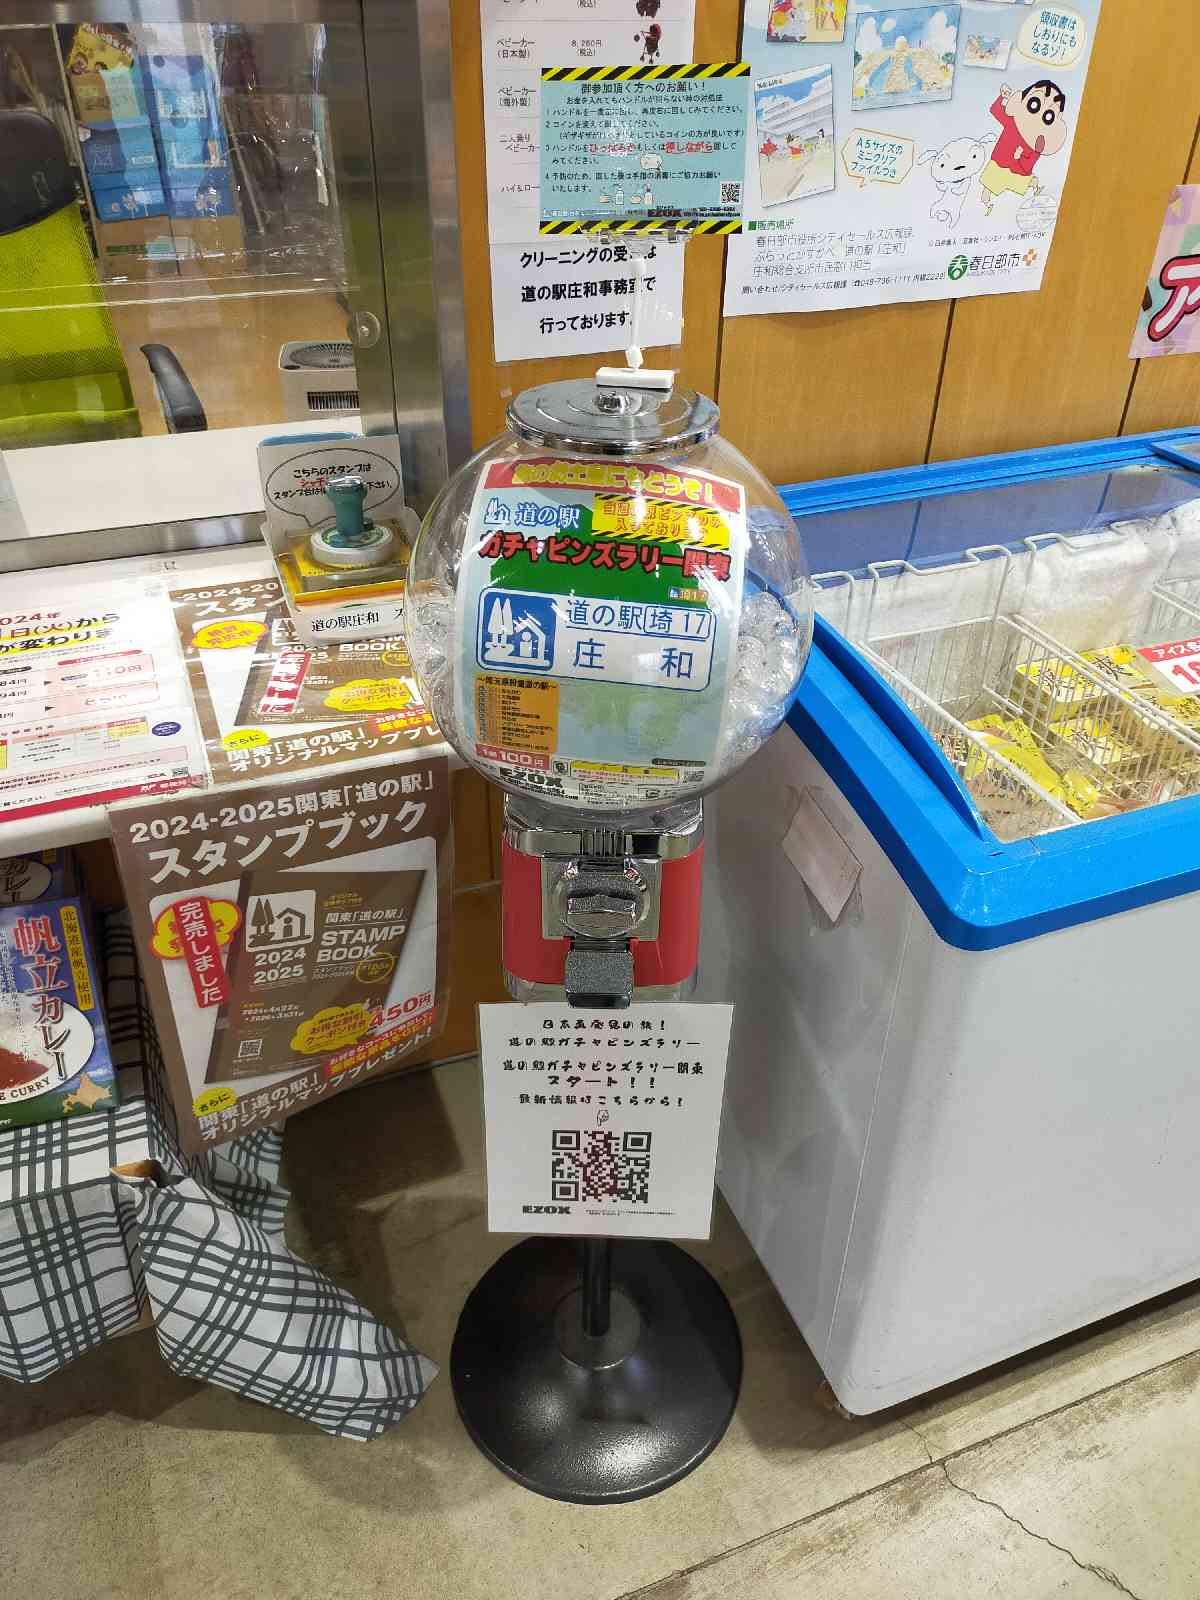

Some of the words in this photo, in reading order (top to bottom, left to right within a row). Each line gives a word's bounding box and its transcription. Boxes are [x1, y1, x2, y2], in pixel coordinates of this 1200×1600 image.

[497, 38, 535, 48] ベビーカー
[498, 88, 536, 97] ベビーカー
[969, 253, 1020, 271] 春日部市
[293, 463, 372, 479] こちらのスタンプは
[515, 502, 581, 529] 道の駅
[311, 612, 379, 632] 道の駅庄和
[566, 600, 644, 631] 道の駅
[228, 727, 366, 761] 関東「道の駅」
[129, 770, 434, 844] 2024-2025関東「道の駅」
[149, 800, 428, 883] スタンプブック
[325, 907, 404, 924] 関東「道の駅」
[320, 925, 405, 946] STAMP
[178, 900, 224, 1005] 完売しました
[254, 947, 307, 967] 2024
[316, 943, 378, 962] BOOK
[12, 915, 72, 1081] 帆立カレー
[508, 1036, 701, 1048] 道の駅ガチャピンズラリー
[502, 1059, 704, 1075] 道の駅ガチャピンズラリー関東
[11, 1076, 50, 1098] CURRY
[199, 1071, 319, 1130] 関東「道の駅」
[518, 1093, 684, 1107] 最新情報はこちらから！
[522, 1204, 572, 1216] EZOX
